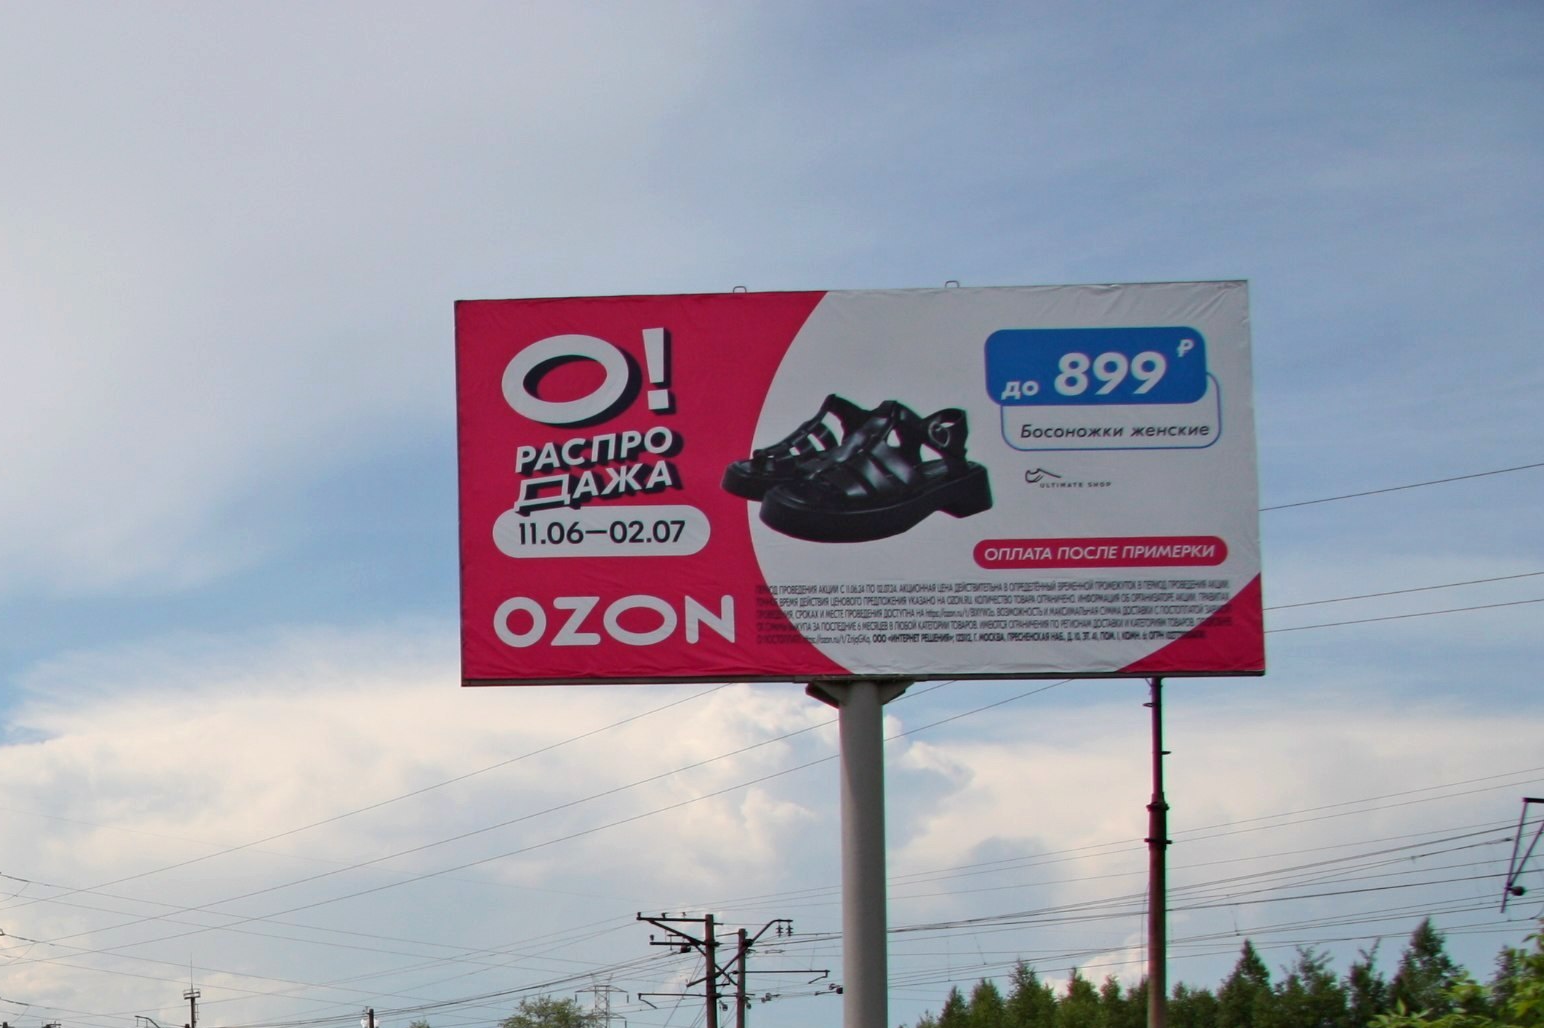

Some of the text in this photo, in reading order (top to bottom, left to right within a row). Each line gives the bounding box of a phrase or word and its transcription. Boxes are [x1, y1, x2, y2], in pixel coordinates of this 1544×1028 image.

[502, 327, 669, 424] О!
[1001, 380, 1039, 400] до
[1054, 351, 1167, 396] 899
[515, 426, 675, 474] РАСПРО
[1020, 424, 1210, 439] Босоножки женские
[514, 460, 674, 512] ДАЖА
[984, 544, 1216, 561] ОПЛАТА ПОСЛЕ ПРИМЕРКИ
[493, 595, 735, 647] OZON
